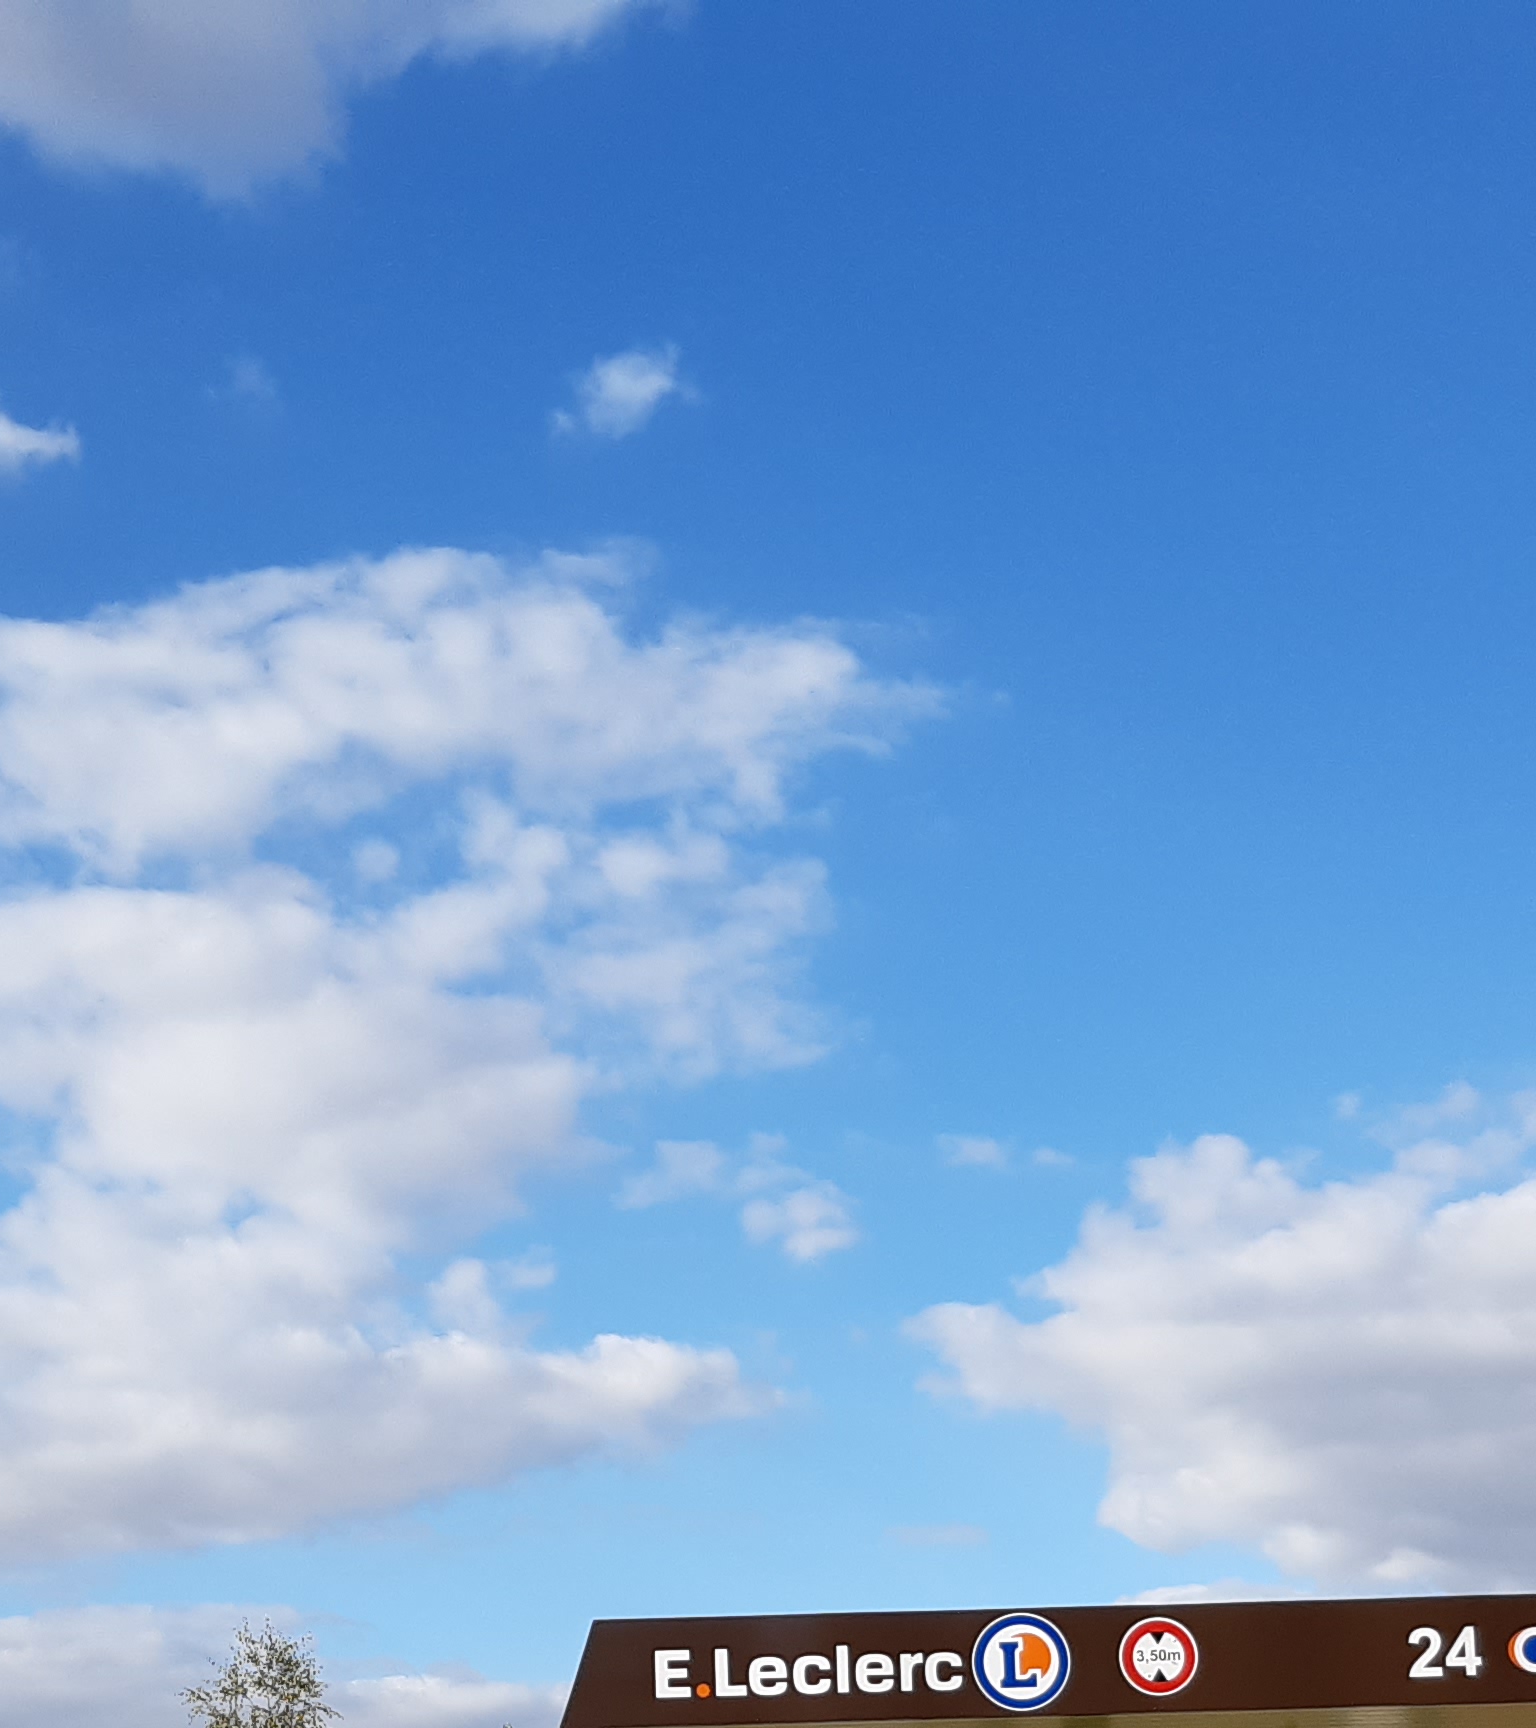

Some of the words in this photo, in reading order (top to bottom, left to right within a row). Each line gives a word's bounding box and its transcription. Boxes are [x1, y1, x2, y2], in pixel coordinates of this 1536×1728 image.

[654, 1645, 963, 1699] E.Leclerc
[1136, 1649, 1181, 1664] 3,50m
[1408, 1625, 1483, 1678] 24
